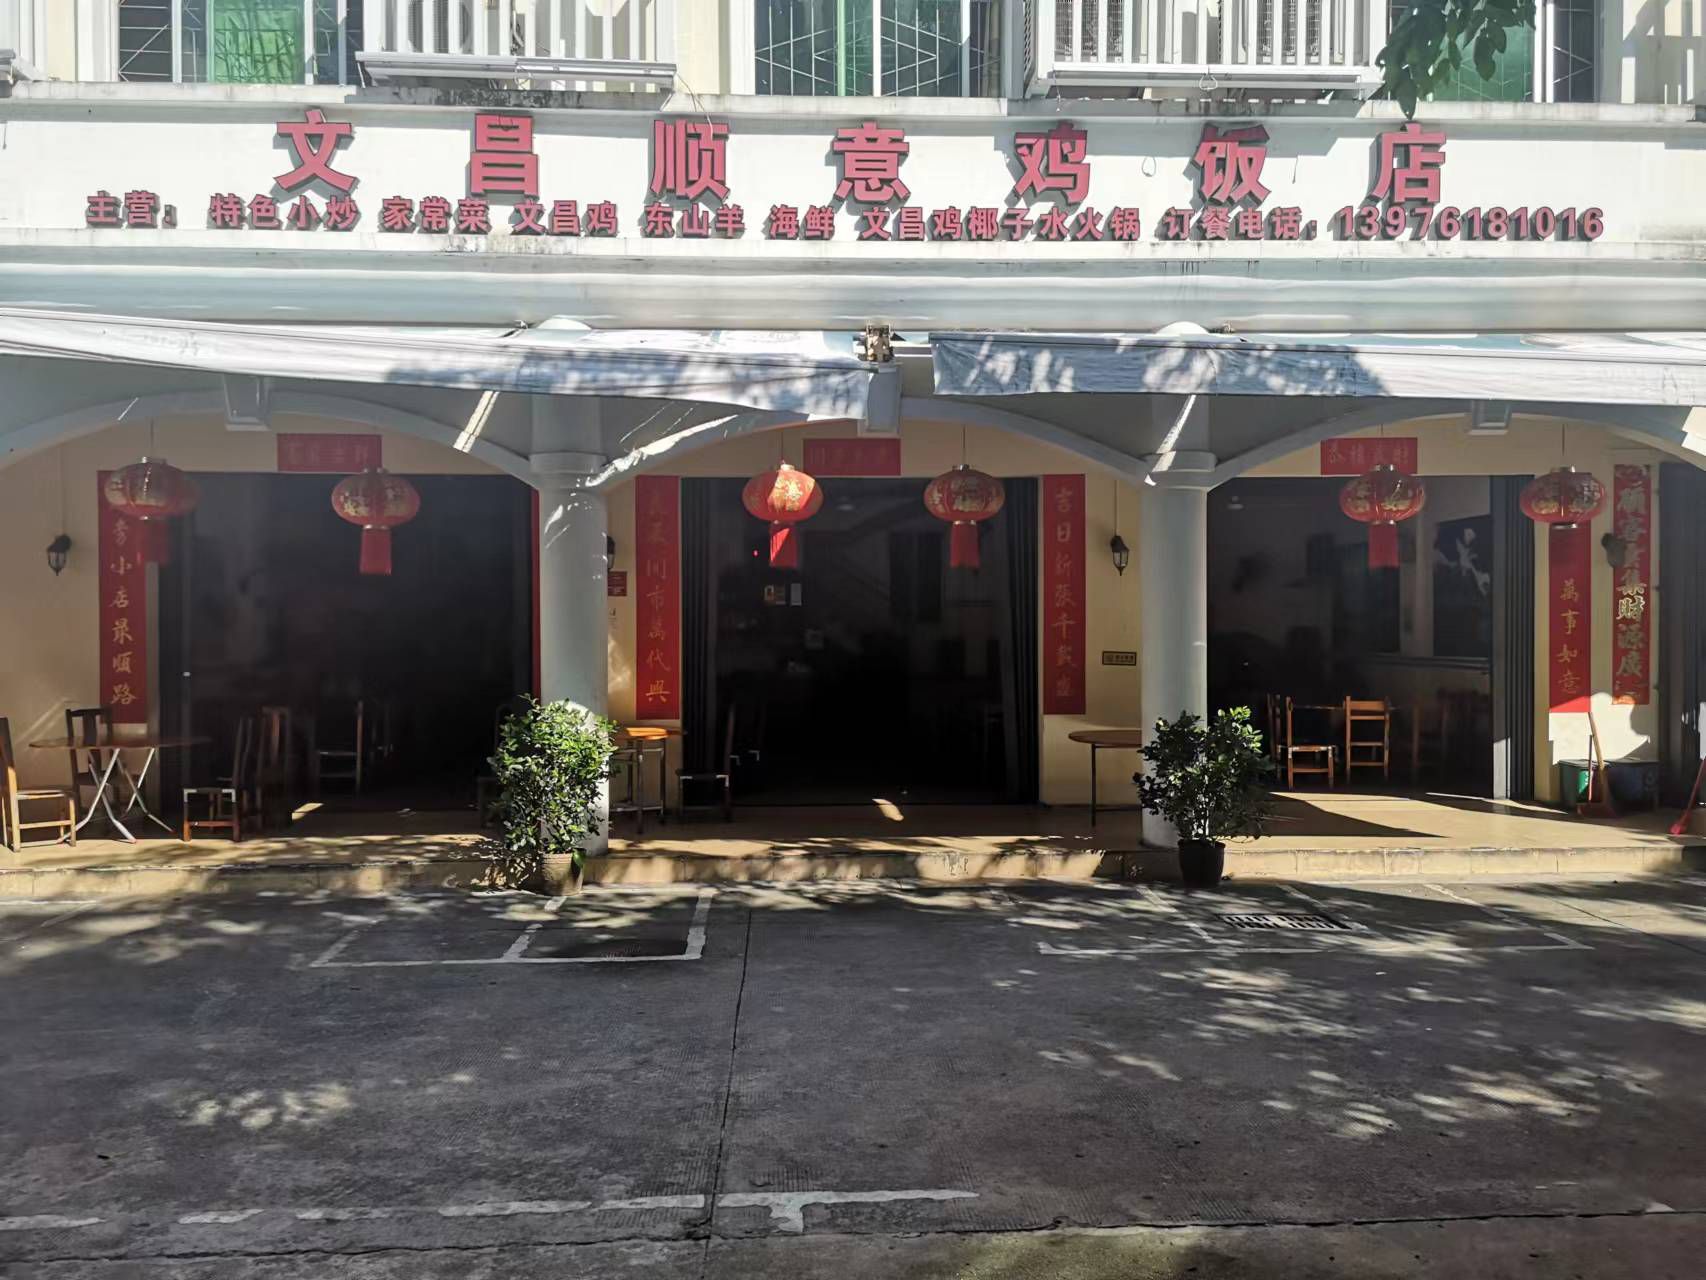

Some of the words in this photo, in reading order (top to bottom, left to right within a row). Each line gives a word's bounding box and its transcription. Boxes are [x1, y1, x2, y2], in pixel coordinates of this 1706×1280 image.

[274, 109, 1447, 205] 文昌顺意鸡饭店
[210, 193, 359, 229] 特色小炒
[382, 196, 490, 232] 家常菜
[512, 199, 617, 235] 文昌鸡
[645, 202, 745, 238] 东山羊
[769, 204, 835, 239] 海鲜
[862, 206, 1141, 241] 文昌鸡椰子水火锅
[1339, 207, 1604, 239] 13976181016
